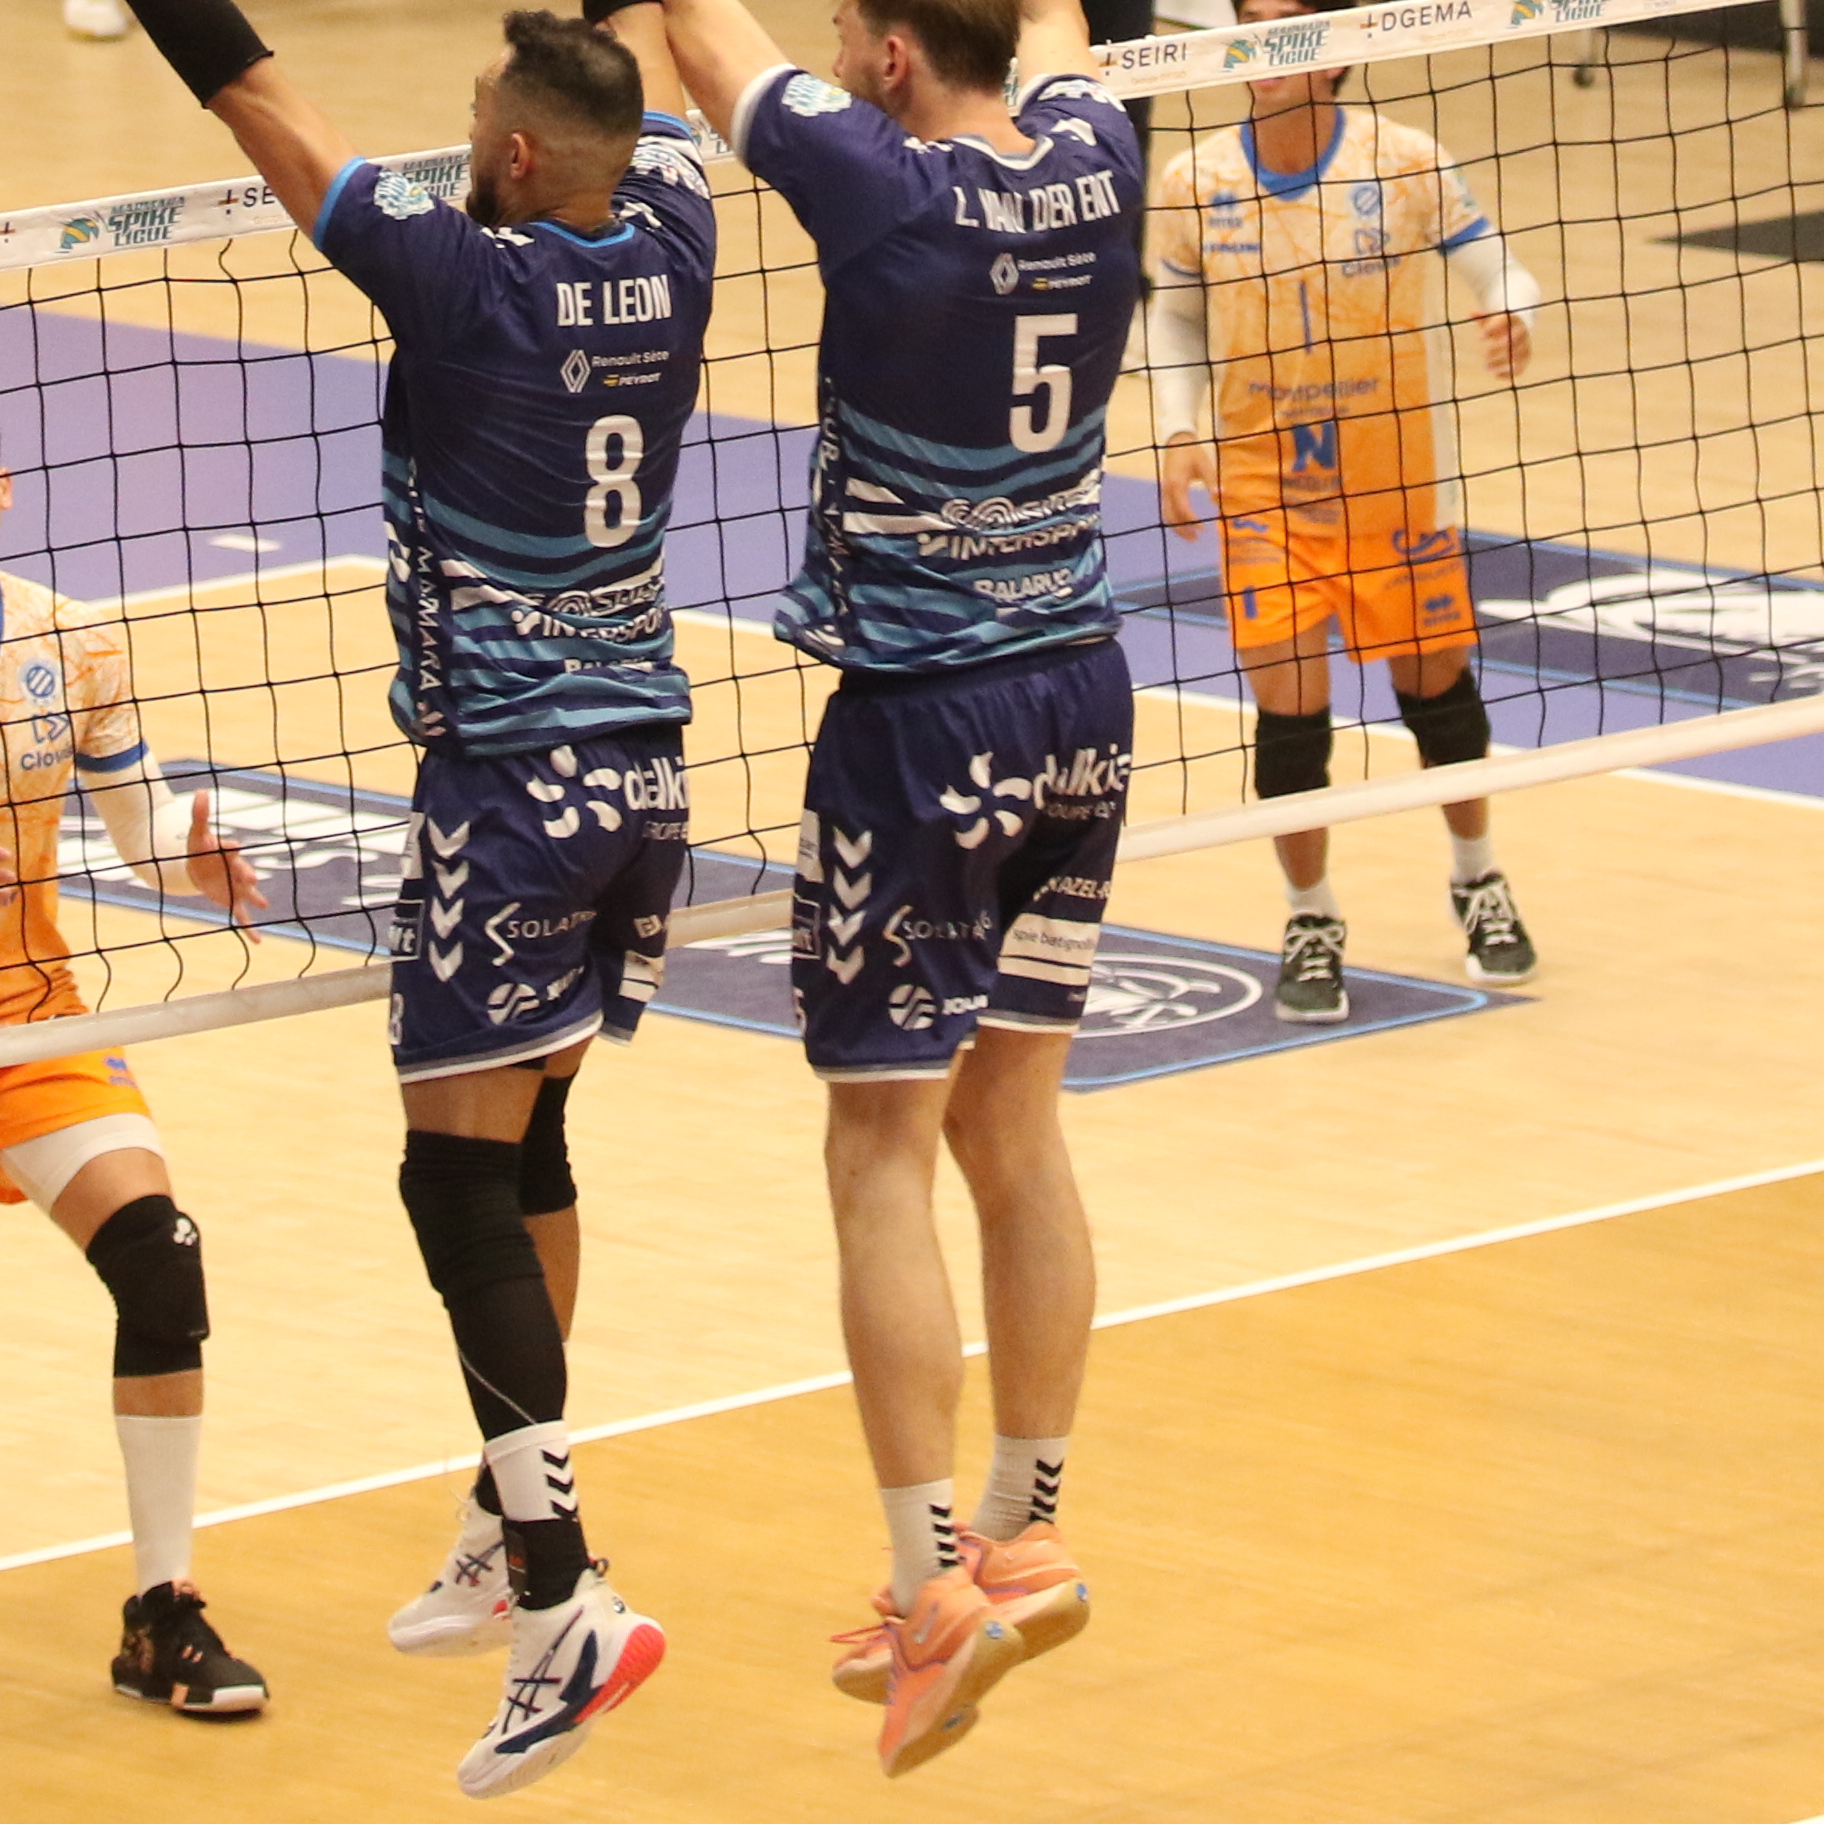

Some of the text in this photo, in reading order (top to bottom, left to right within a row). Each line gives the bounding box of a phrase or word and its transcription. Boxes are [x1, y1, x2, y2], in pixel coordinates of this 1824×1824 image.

[1381, 0, 1474, 33] DGEMA
[1121, 42, 1189, 71] SEIRI
[1262, 28, 1329, 57] SPIKE
[106, 205, 185, 234] SPIKE
[1029, 182, 1079, 232] DER
[1074, 169, 1121, 222] ENT
[114, 225, 174, 248] LIGUE
[555, 273, 673, 327] DE LEON
[1009, 313, 1078, 454] 5
[582, 414, 644, 549] 8
[625, 756, 689, 811] dalki
